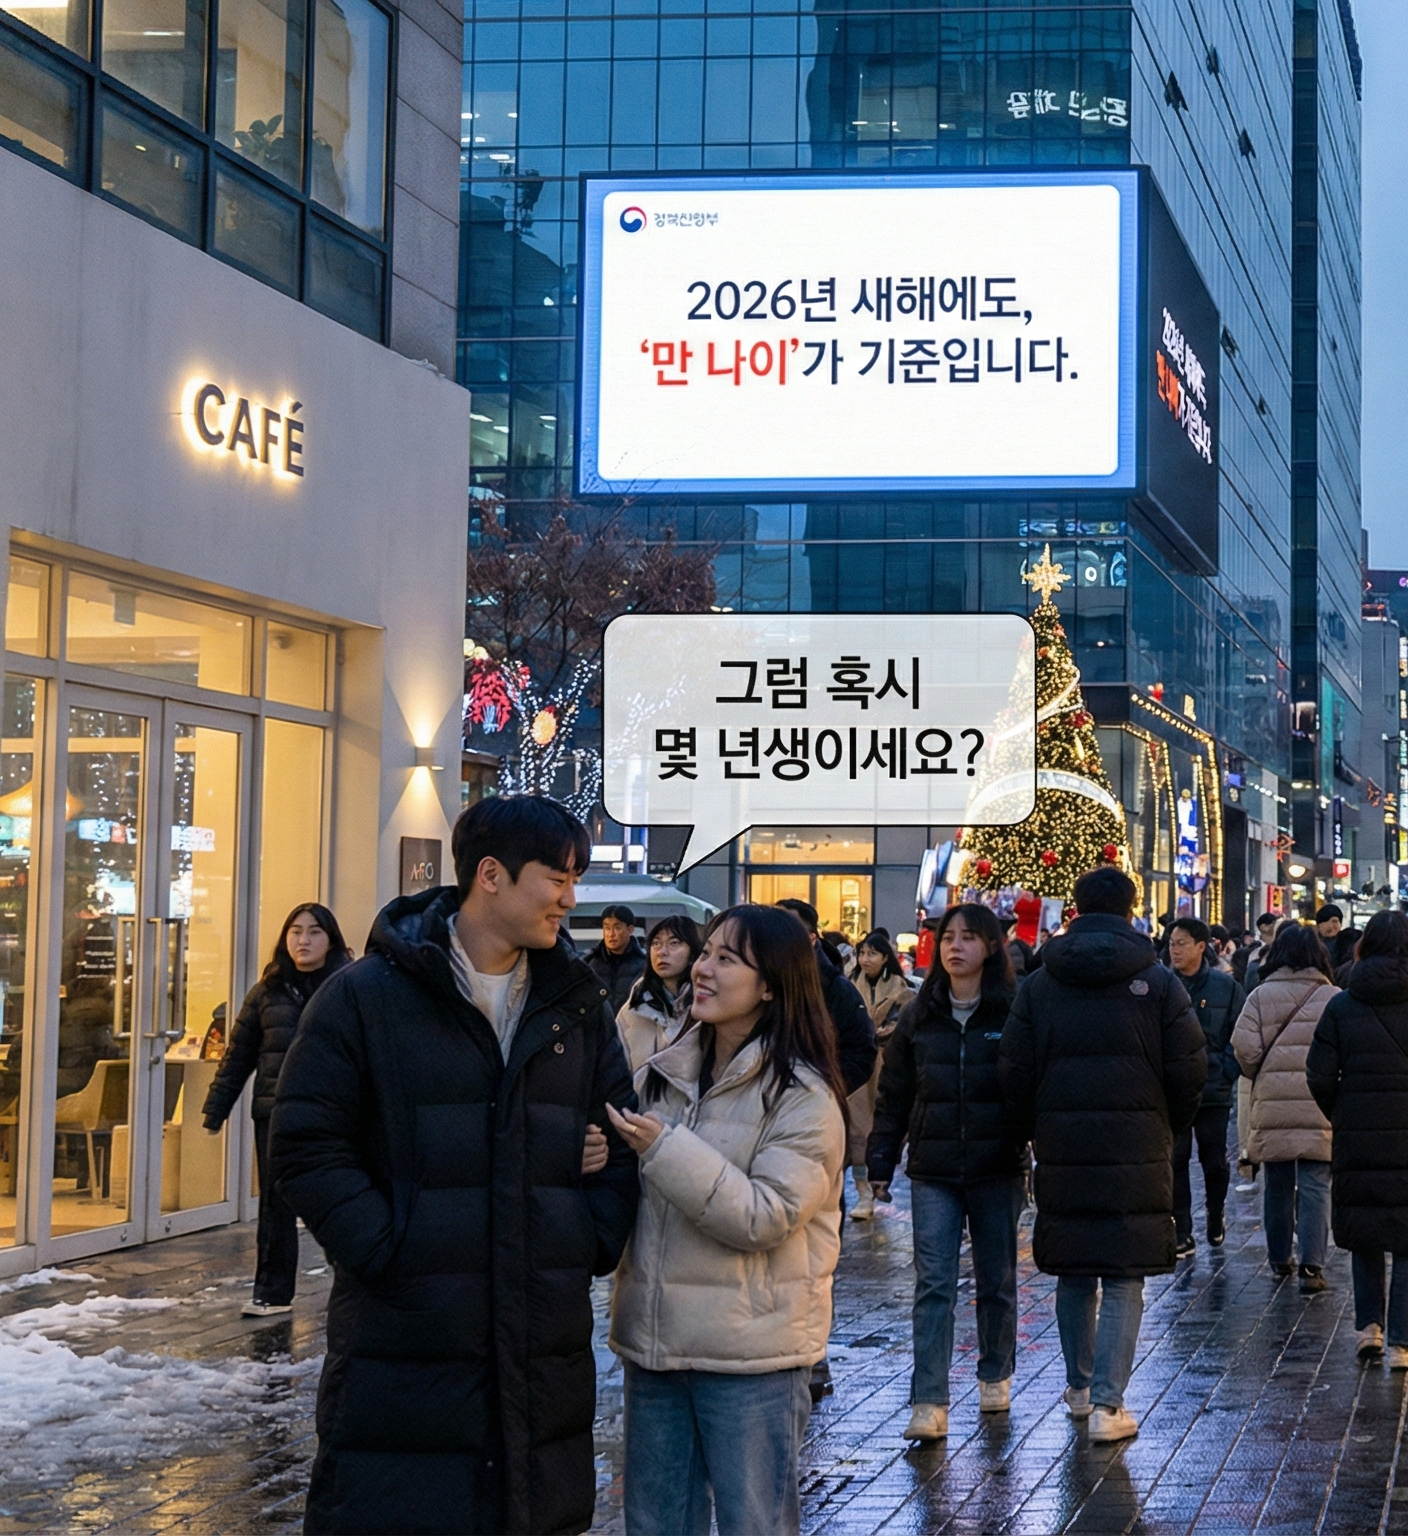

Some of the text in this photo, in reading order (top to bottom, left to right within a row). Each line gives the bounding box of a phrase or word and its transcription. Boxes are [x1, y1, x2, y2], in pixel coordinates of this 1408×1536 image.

[687, 275, 1033, 326] 2026년 새해에도,
[858, 336, 1078, 385] 기준입니다.
[194, 383, 304, 478] CAFÉ
